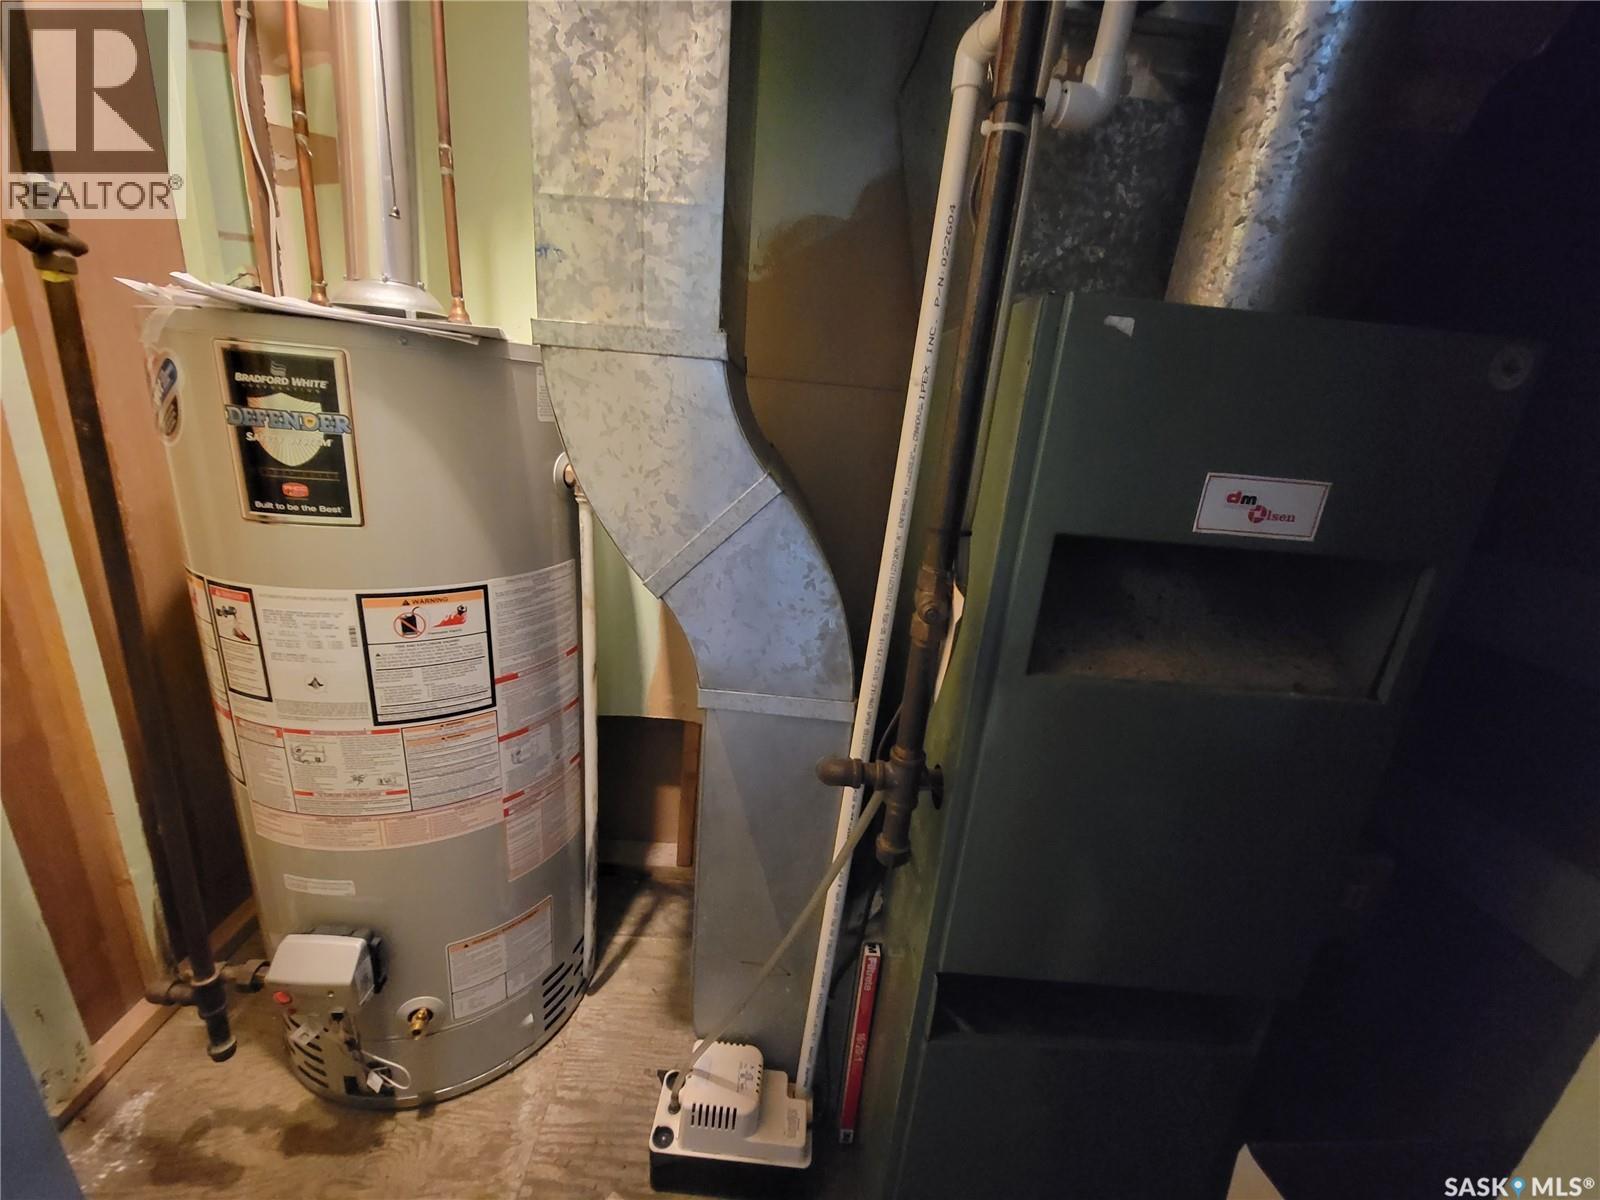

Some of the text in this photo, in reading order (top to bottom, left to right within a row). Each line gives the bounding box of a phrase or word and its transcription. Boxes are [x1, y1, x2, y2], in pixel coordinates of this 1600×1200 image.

[235, 372, 289, 385] BRADFORD
[291, 377, 328, 389] WHITE
[918, 365, 931, 400] IPEX
[226, 405, 352, 434] DEFENDER
[255, 501, 274, 509] Built
[287, 503, 299, 511] be
[1248, 505, 1296, 523] Olsen
[411, 597, 449, 605] WARNING
